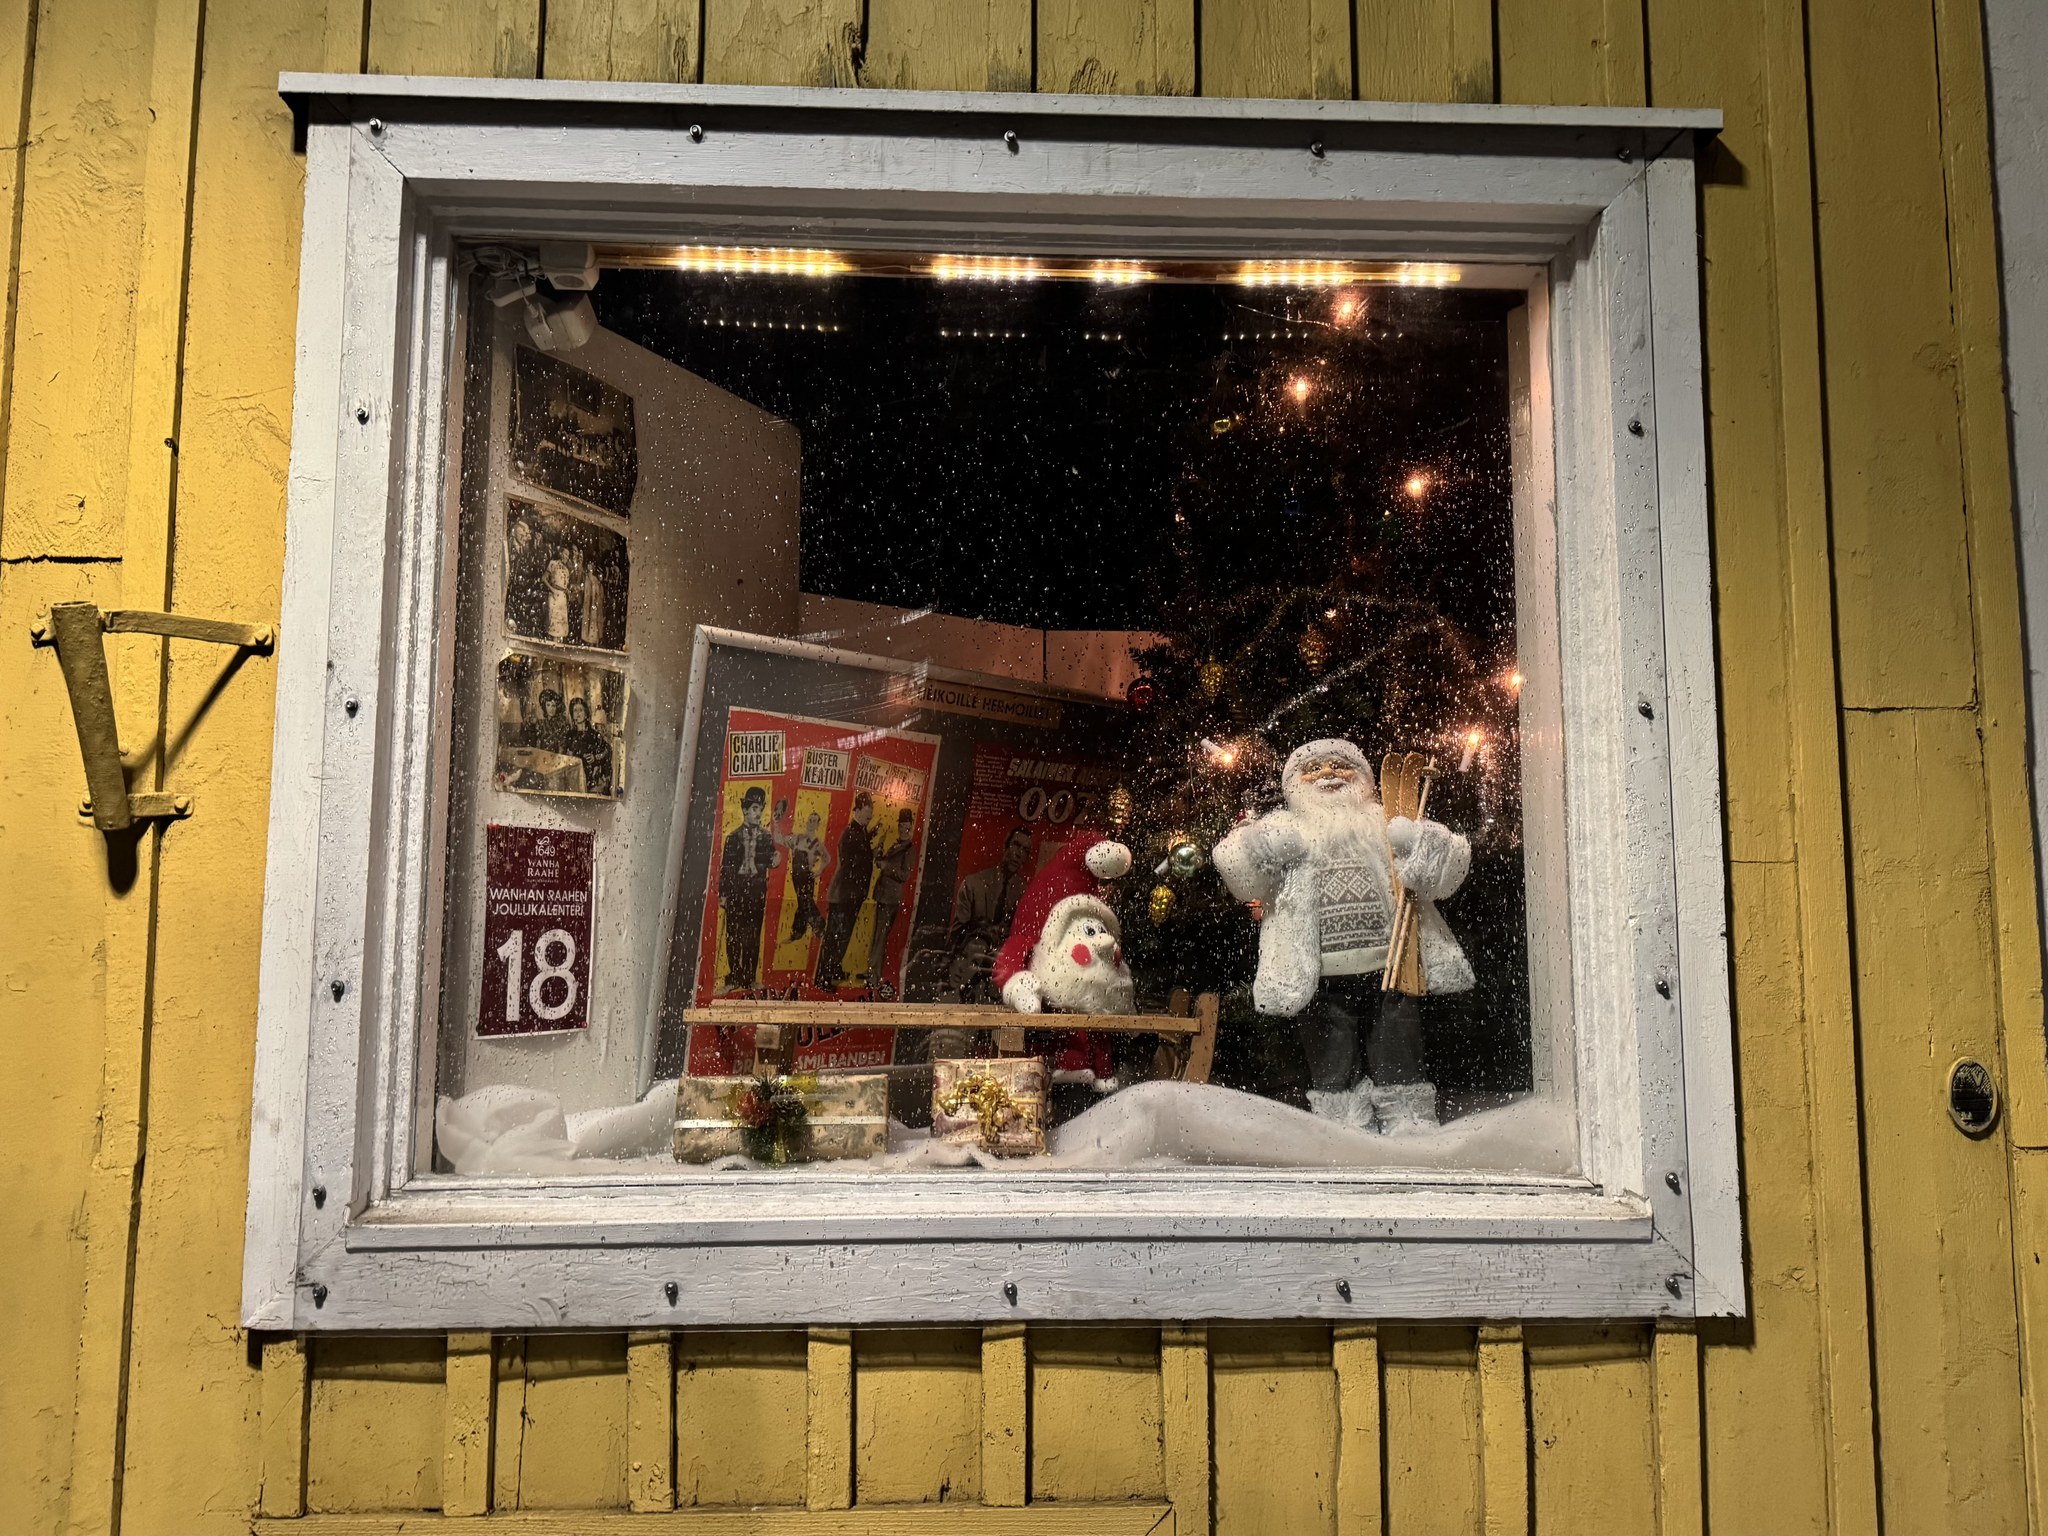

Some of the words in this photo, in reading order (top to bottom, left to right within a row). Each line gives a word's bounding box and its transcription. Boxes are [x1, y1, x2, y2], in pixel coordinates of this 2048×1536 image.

[733, 734, 779, 753] CHARLIE
[733, 754, 780, 772] CHAPLIN
[806, 752, 839, 768] BUSTER
[804, 766, 845, 786] KEATON
[855, 771, 886, 793] HARDY
[1019, 787, 1097, 824] 007
[534, 844, 556, 857] 1649
[527, 857, 560, 869] WANHA
[527, 867, 560, 878] RAAHE
[490, 887, 545, 901] WANHAN
[547, 889, 588, 902] RAAHEN
[492, 903, 584, 917] JOULUKALENTERI
[497, 928, 578, 1022] 18
